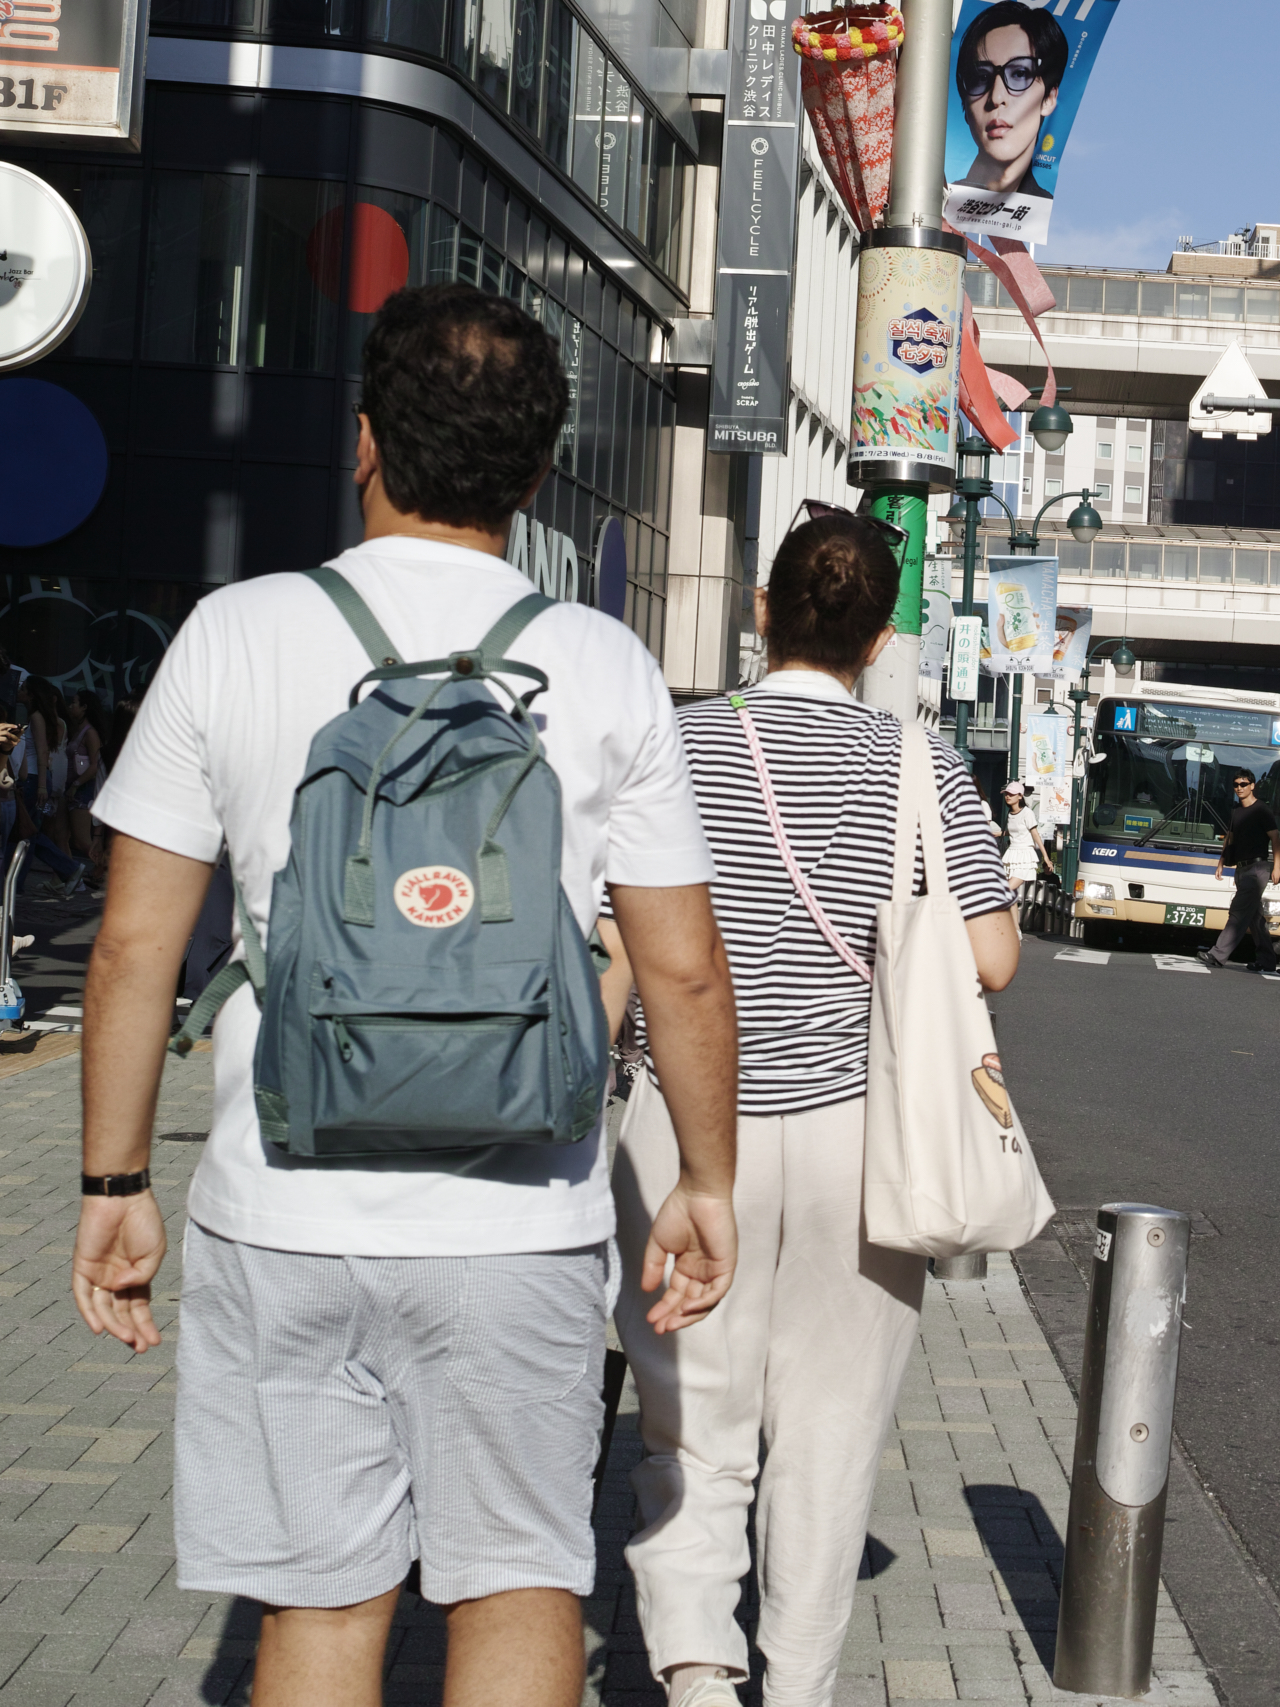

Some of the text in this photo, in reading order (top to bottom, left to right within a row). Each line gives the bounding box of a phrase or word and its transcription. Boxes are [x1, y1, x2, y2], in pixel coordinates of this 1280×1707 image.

[743, 25, 759, 118] クリニック渋谷
[759, 25, 776, 118] 田中レディス
[750, 159, 764, 256] FEELCYCLE
[957, 199, 1031, 221] 渋谷センター街
[744, 286, 759, 374] リアル脱出ゲーム
[889, 320, 952, 346] 칠석 축제
[899, 344, 946, 365] 七夕节
[714, 430, 777, 443] MITSUBA
[904, 556, 919, 567] egal
[956, 624, 971, 692] 井の頭通り
[1092, 847, 1118, 857] KEIO
[1172, 910, 1204, 926] 37-25
